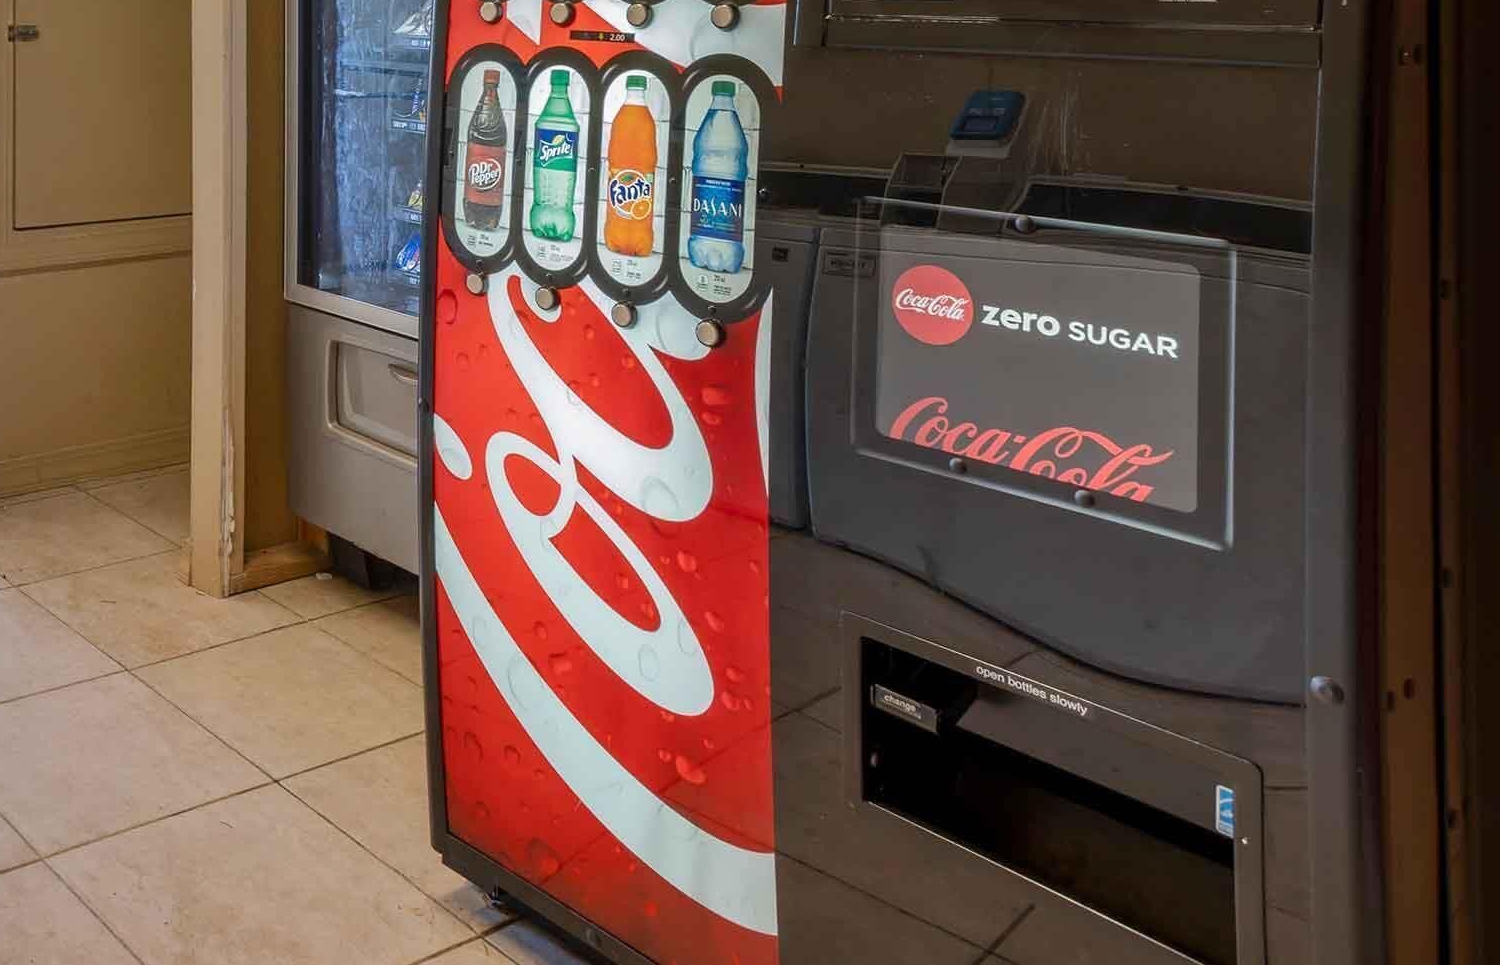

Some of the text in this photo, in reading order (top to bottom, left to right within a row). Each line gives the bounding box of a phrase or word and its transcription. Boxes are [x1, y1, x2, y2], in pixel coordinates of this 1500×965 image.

[610, 33, 625, 42] 2.00
[540, 141, 571, 161] Sprite
[469, 163, 499, 186] Pepper
[480, 161, 493, 174] Dr
[609, 176, 652, 207] Fanta
[693, 195, 742, 218] DASANI
[895, 288, 970, 322] Coca-Cola
[980, 304, 1179, 359] zero SUGAR
[975, 666, 1088, 716] open bottles slowly
[883, 694, 917, 713] change
